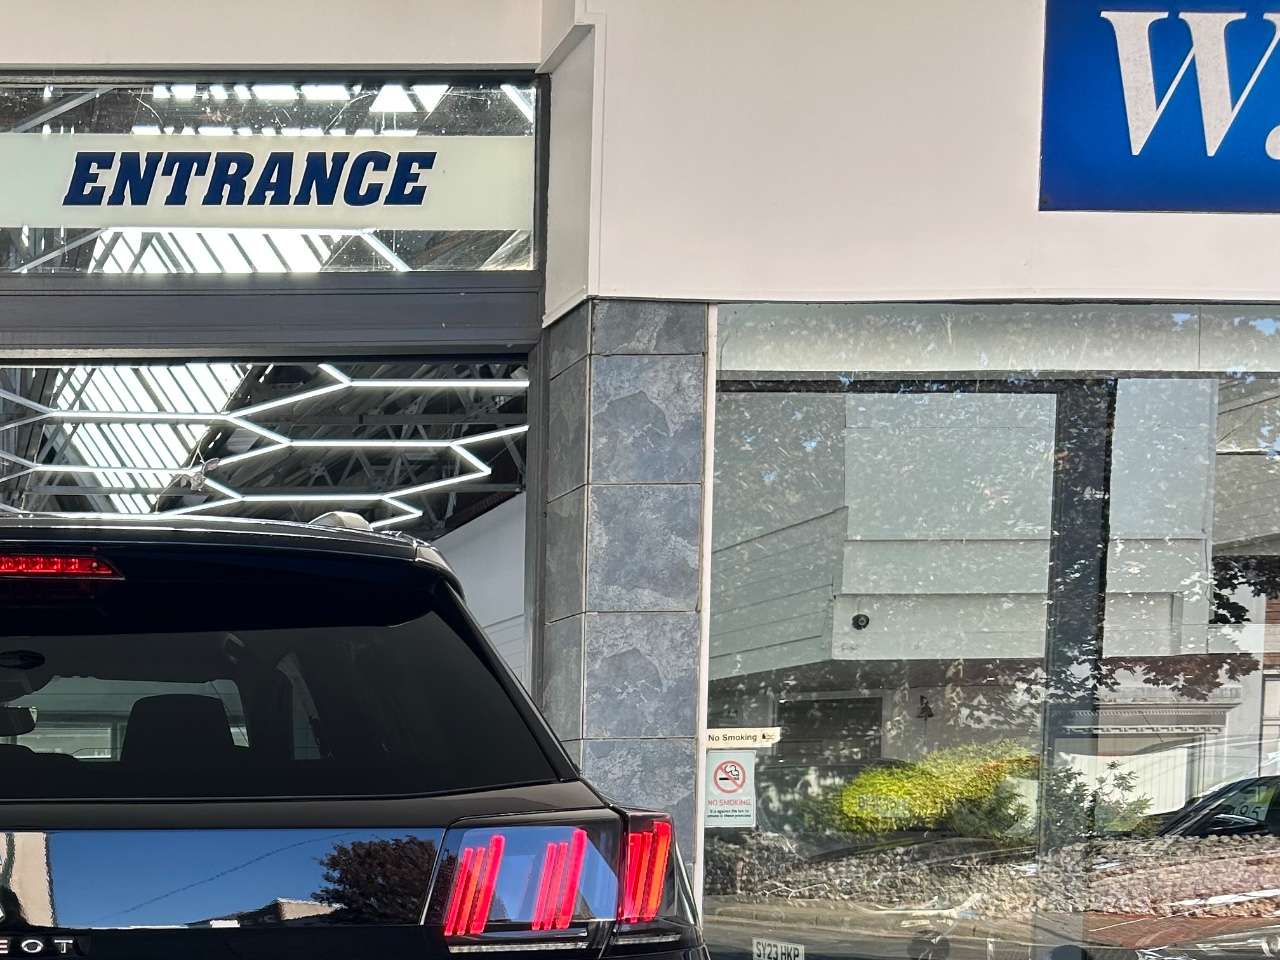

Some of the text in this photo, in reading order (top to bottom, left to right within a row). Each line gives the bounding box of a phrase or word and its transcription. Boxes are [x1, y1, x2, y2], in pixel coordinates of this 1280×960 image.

[61, 150, 438, 207] ENTRANCE
[722, 734, 757, 742] Smoking
[756, 941, 779, 960] SY23
